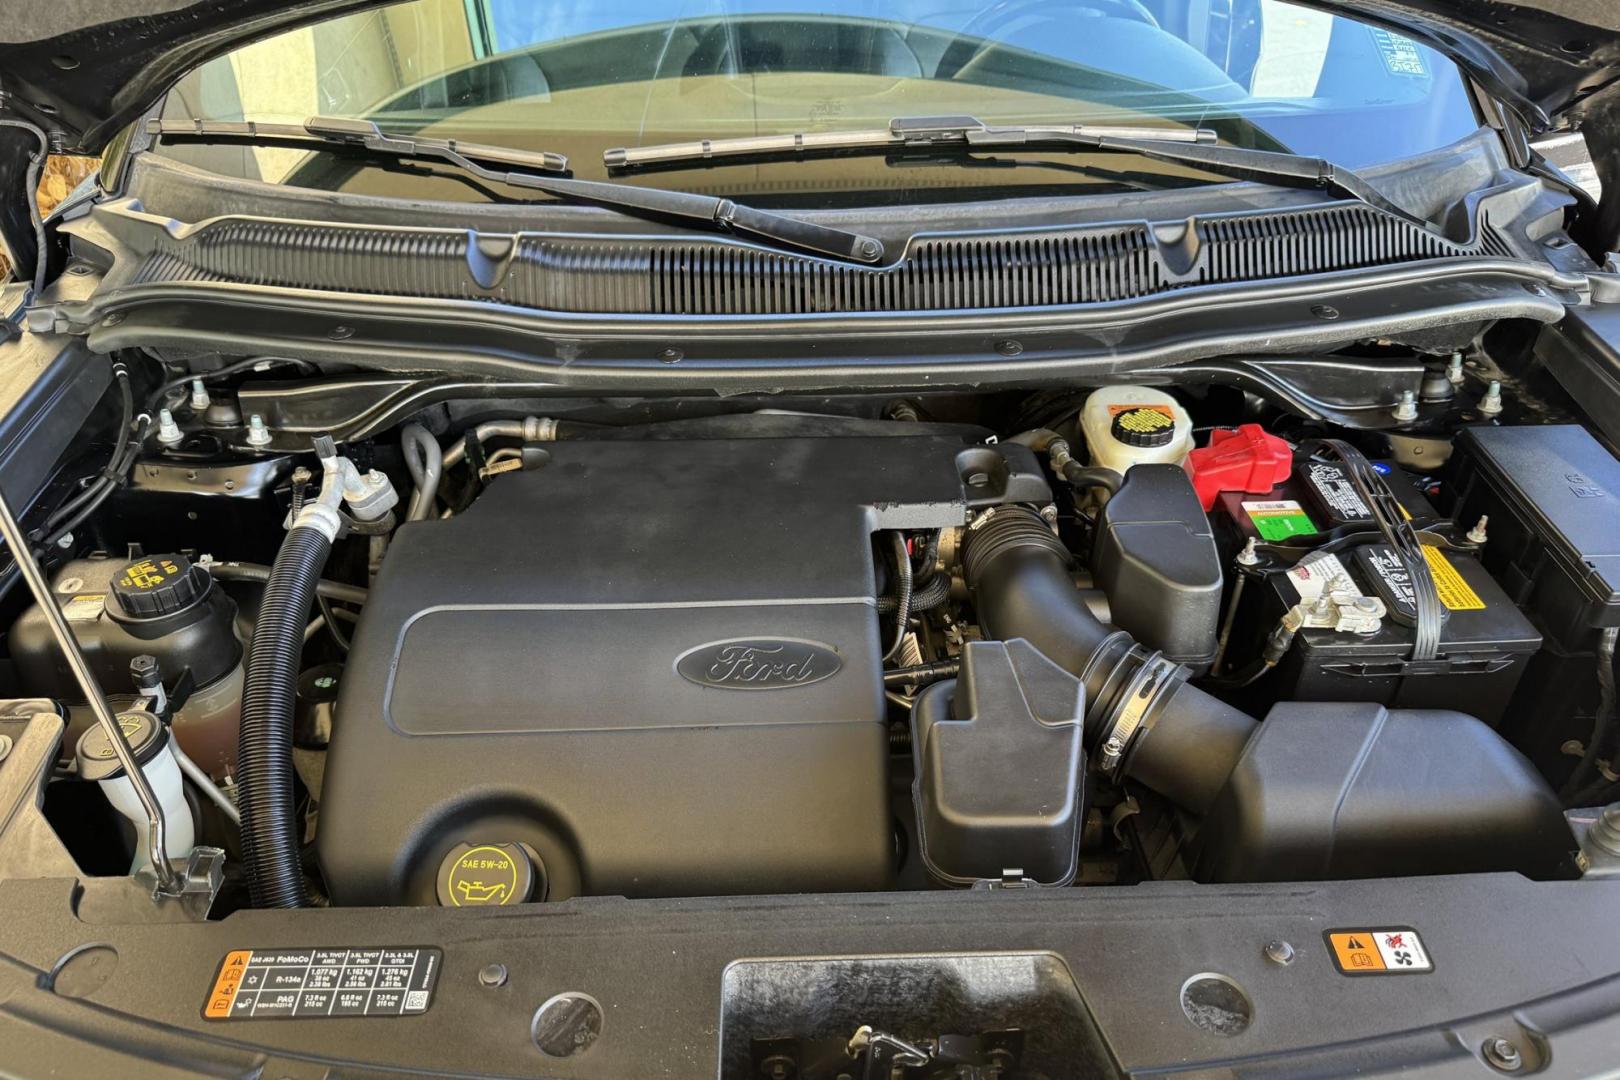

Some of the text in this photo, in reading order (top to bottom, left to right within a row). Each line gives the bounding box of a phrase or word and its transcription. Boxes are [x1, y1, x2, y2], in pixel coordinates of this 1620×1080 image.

[706, 644, 814, 682] Ford
[462, 860, 508, 869] SAE 5W-20
